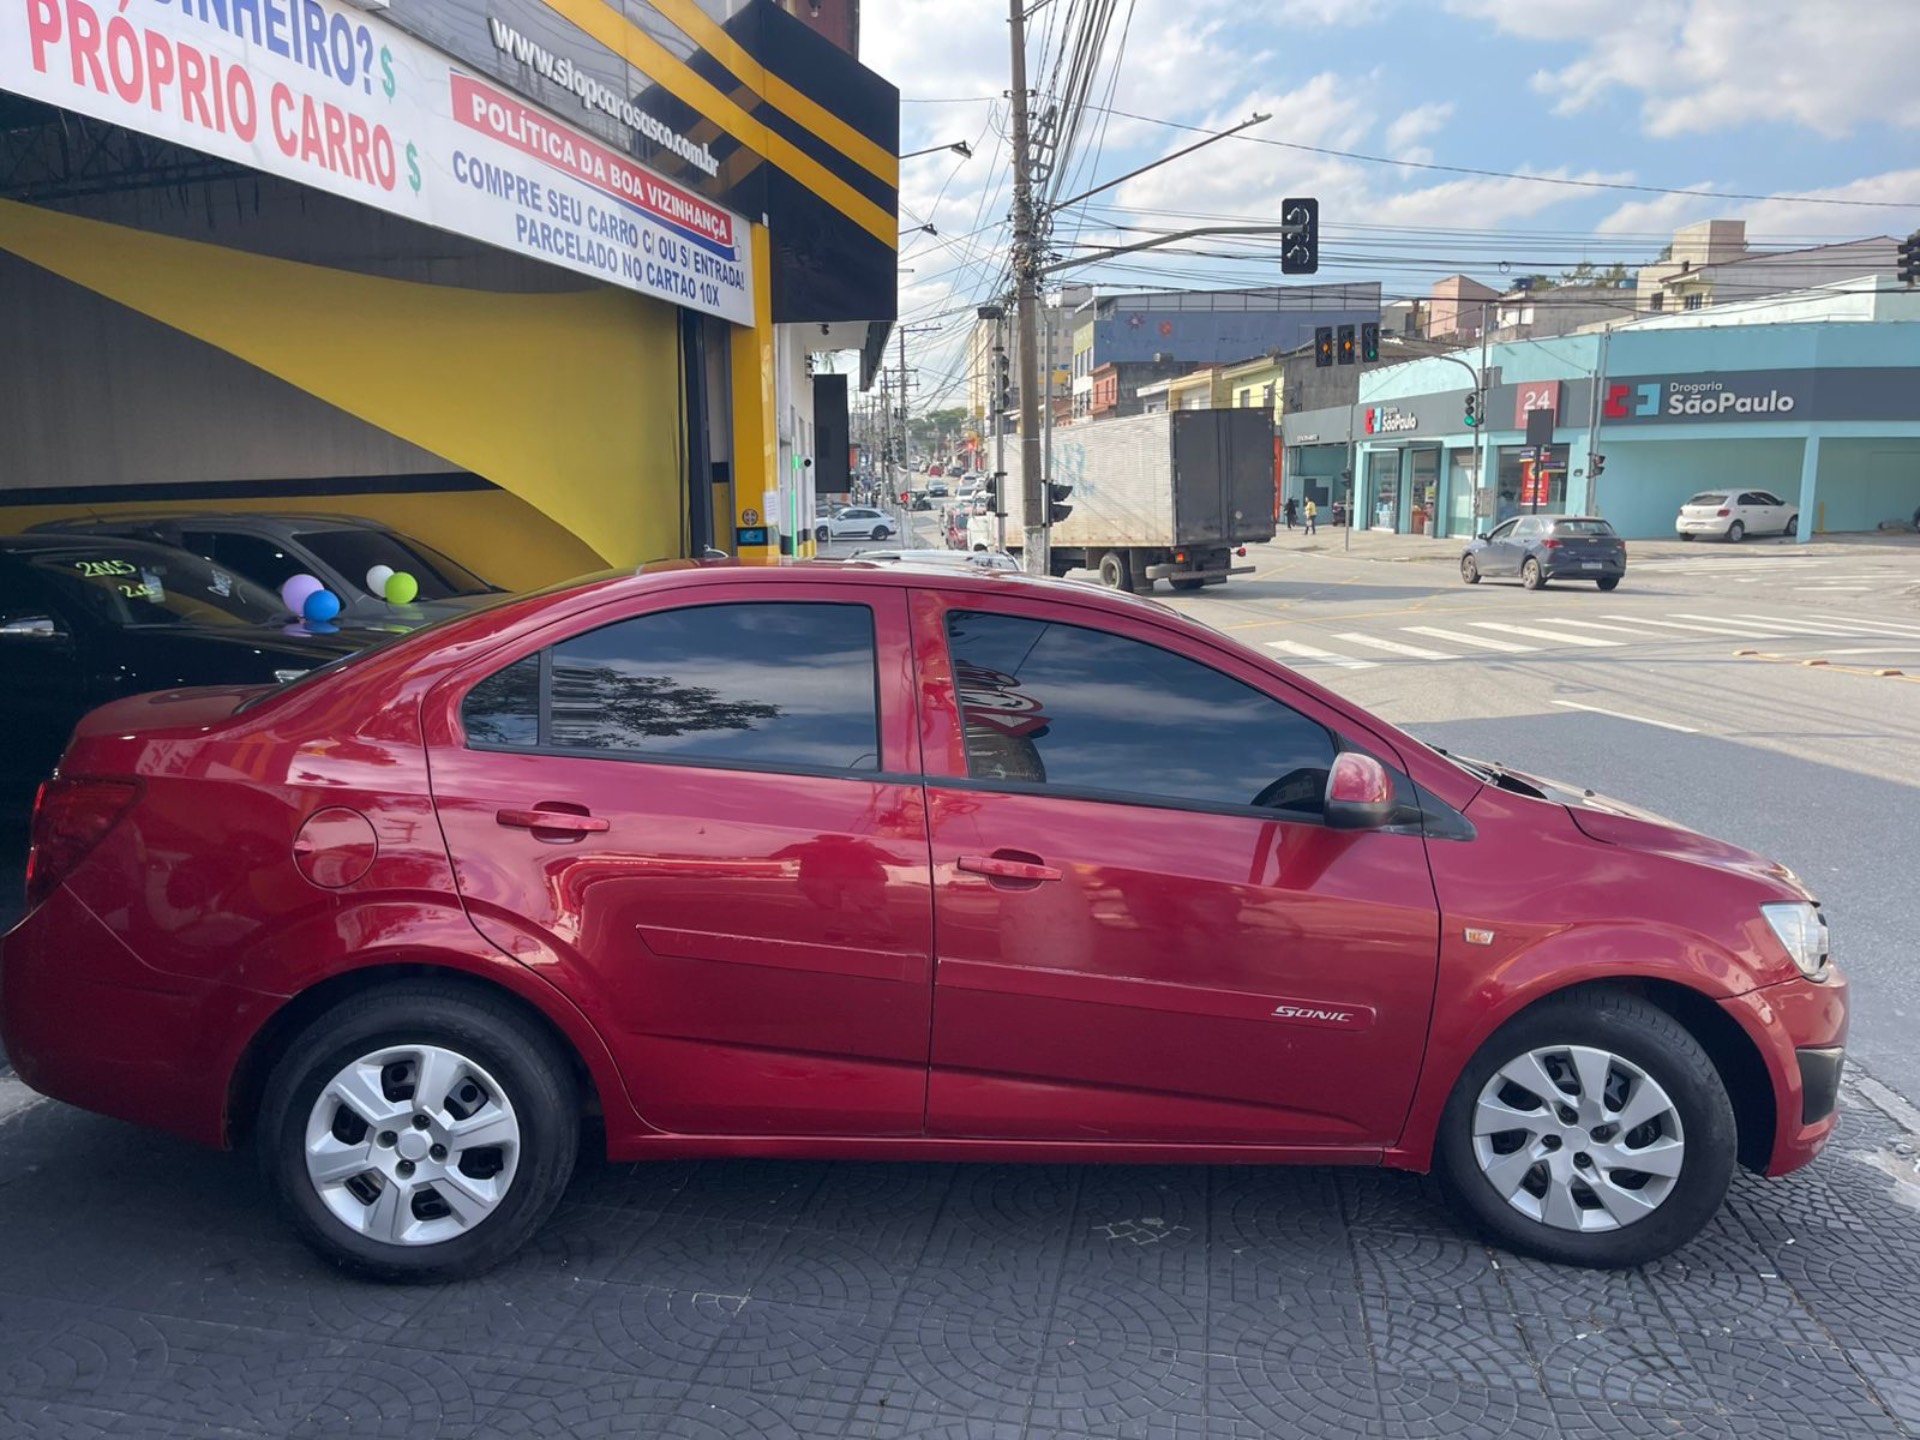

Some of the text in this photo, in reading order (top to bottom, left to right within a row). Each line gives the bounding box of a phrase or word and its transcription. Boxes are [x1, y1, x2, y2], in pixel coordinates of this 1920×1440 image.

[155, 0, 372, 95] HEIRO?
[27, 0, 257, 143] PRÓPRIO
[271, 82, 396, 192] CARRO
[471, 93, 727, 239] POLÍTICA DA BOA VIZINHANÇA
[452, 150, 542, 211] COMPRE
[547, 188, 582, 227] SEU
[588, 205, 638, 248] CARRO
[659, 236, 676, 263] OU
[694, 251, 744, 291] ENTRADA!
[515, 213, 720, 307] PARCELADO NO CARTAO 10X
[1523, 390, 1550, 410] 24
[1670, 382, 1722, 394] Drogaria
[1271, 1005, 1354, 1022] SONIC
